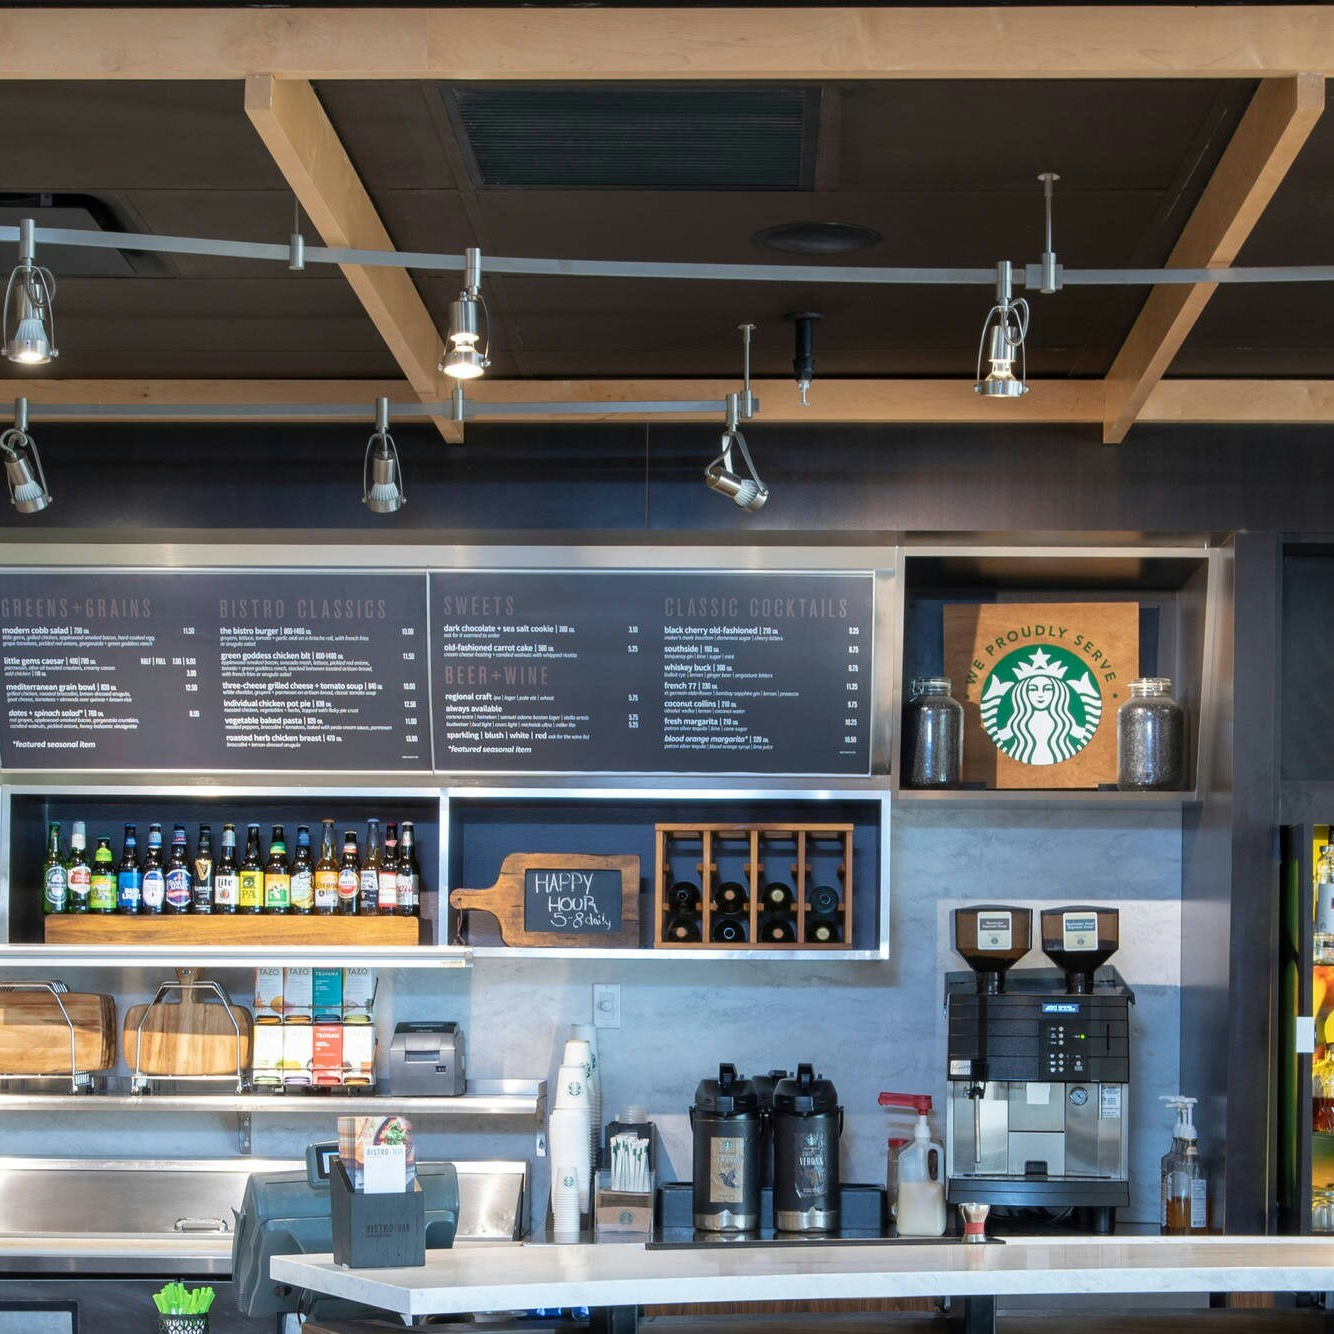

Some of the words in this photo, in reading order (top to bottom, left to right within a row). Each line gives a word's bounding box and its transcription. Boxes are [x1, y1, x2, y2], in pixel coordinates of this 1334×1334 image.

[219, 599, 285, 619] BISTRO
[298, 599, 387, 619] CLASSICS
[444, 596, 515, 616] SWEETS
[664, 598, 739, 618] CLASSIC
[750, 598, 848, 618] COCKTAILS
[2, 626, 30, 634] modern
[255, 627, 279, 636] burger
[664, 626, 684, 634] black
[684, 626, 708, 635] cherry
[709, 626, 758, 634] old-fashioned
[242, 652, 272, 660] goddess
[966, 659, 985, 685] WE
[985, 624, 1068, 656] PROUDLY
[1073, 635, 1117, 682] SERVE
[664, 664, 693, 672] whiskey
[59, 684, 77, 692] grain
[268, 682, 289, 690] grilled
[445, 693, 474, 701] regional
[300, 700, 311, 708] pie
[446, 705, 470, 713] always
[224, 717, 259, 726] vegetable
[684, 718, 718, 726] margarita
[447, 732, 479, 740] sparkling
[218, 878, 232, 888] Lite
[535, 872, 594, 894] HAPPY
[548, 895, 598, 913] HOUR
[550, 912, 584, 928] 5-8
[585, 914, 612, 930] daily
[288, 968, 309, 976] TAZO
[348, 968, 368, 976] TAZO
